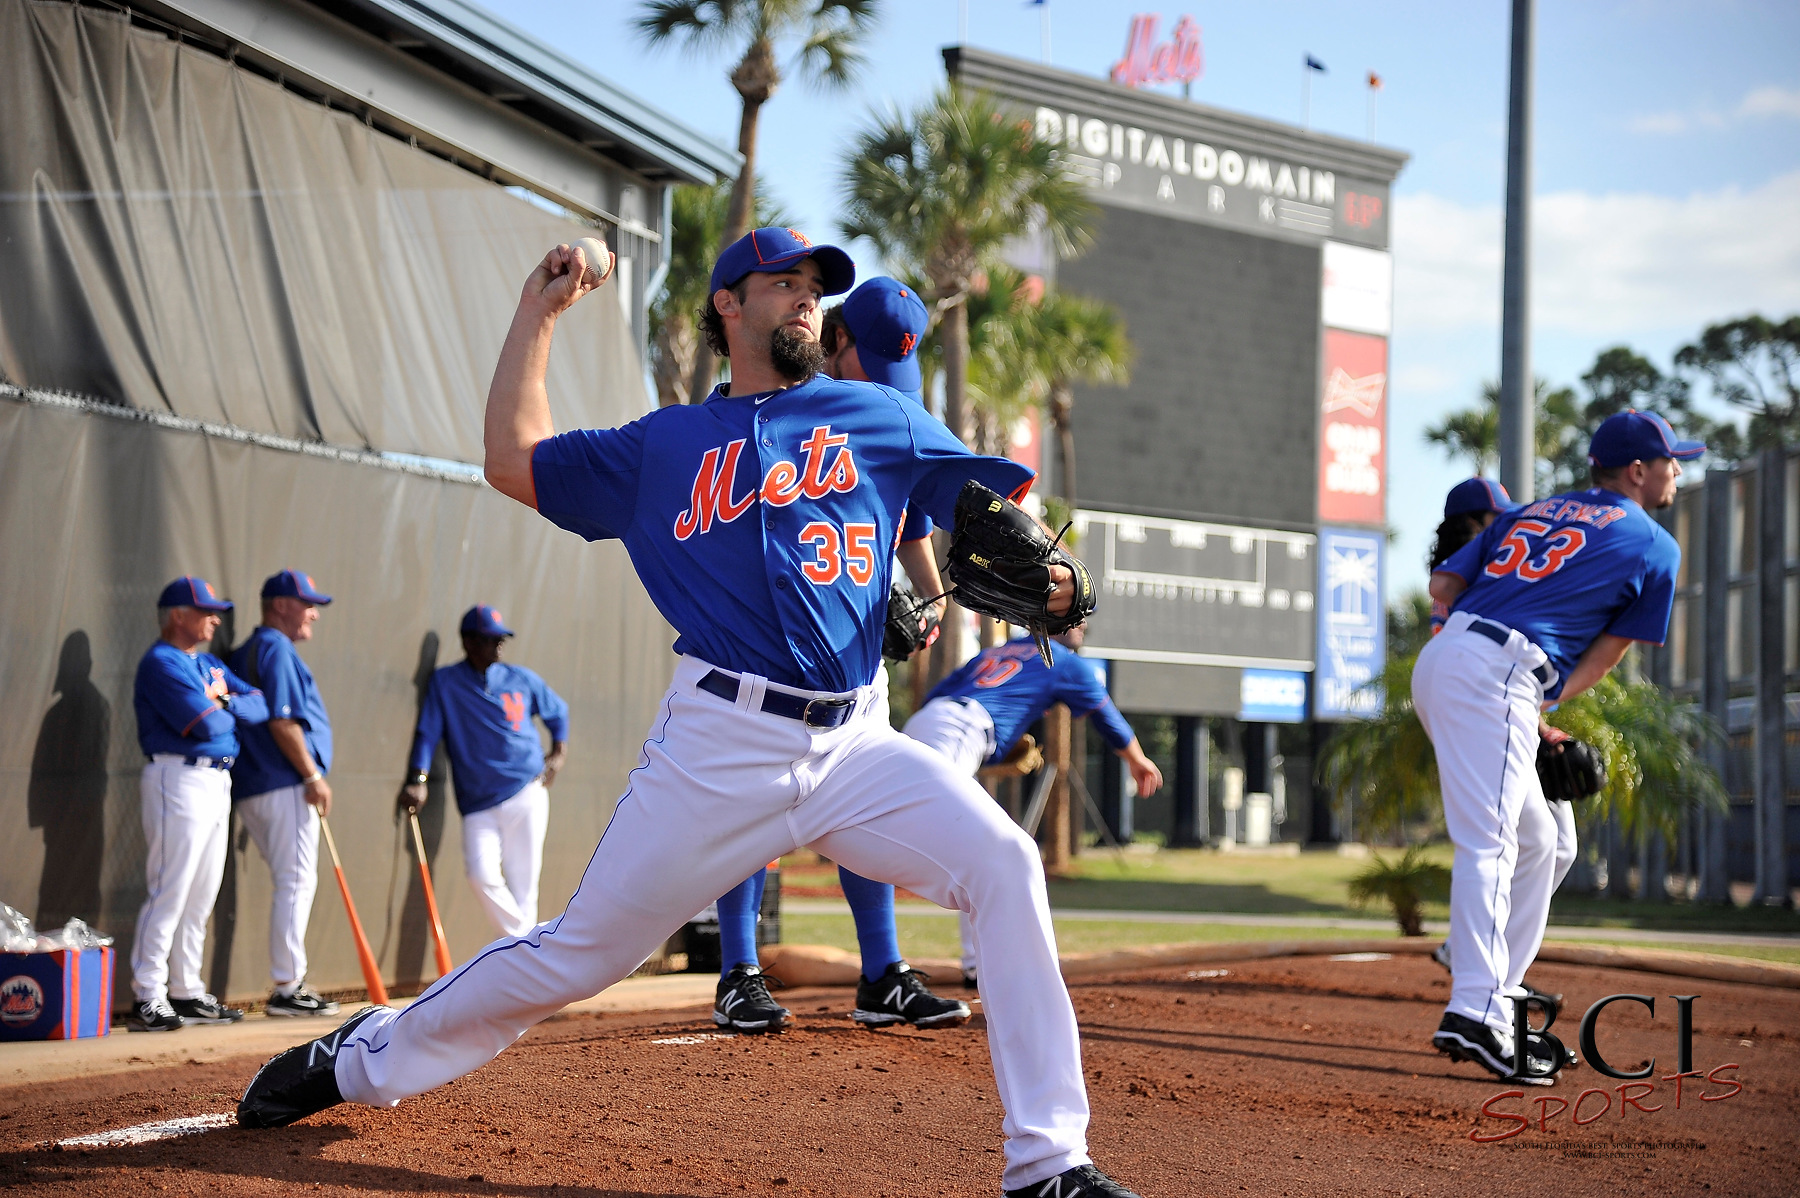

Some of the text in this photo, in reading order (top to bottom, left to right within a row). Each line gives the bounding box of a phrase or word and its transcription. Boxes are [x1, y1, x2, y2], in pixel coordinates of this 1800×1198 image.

[673, 424, 860, 542] Mets
[798, 521, 877, 587] 35
[1485, 519, 1587, 583] 53
